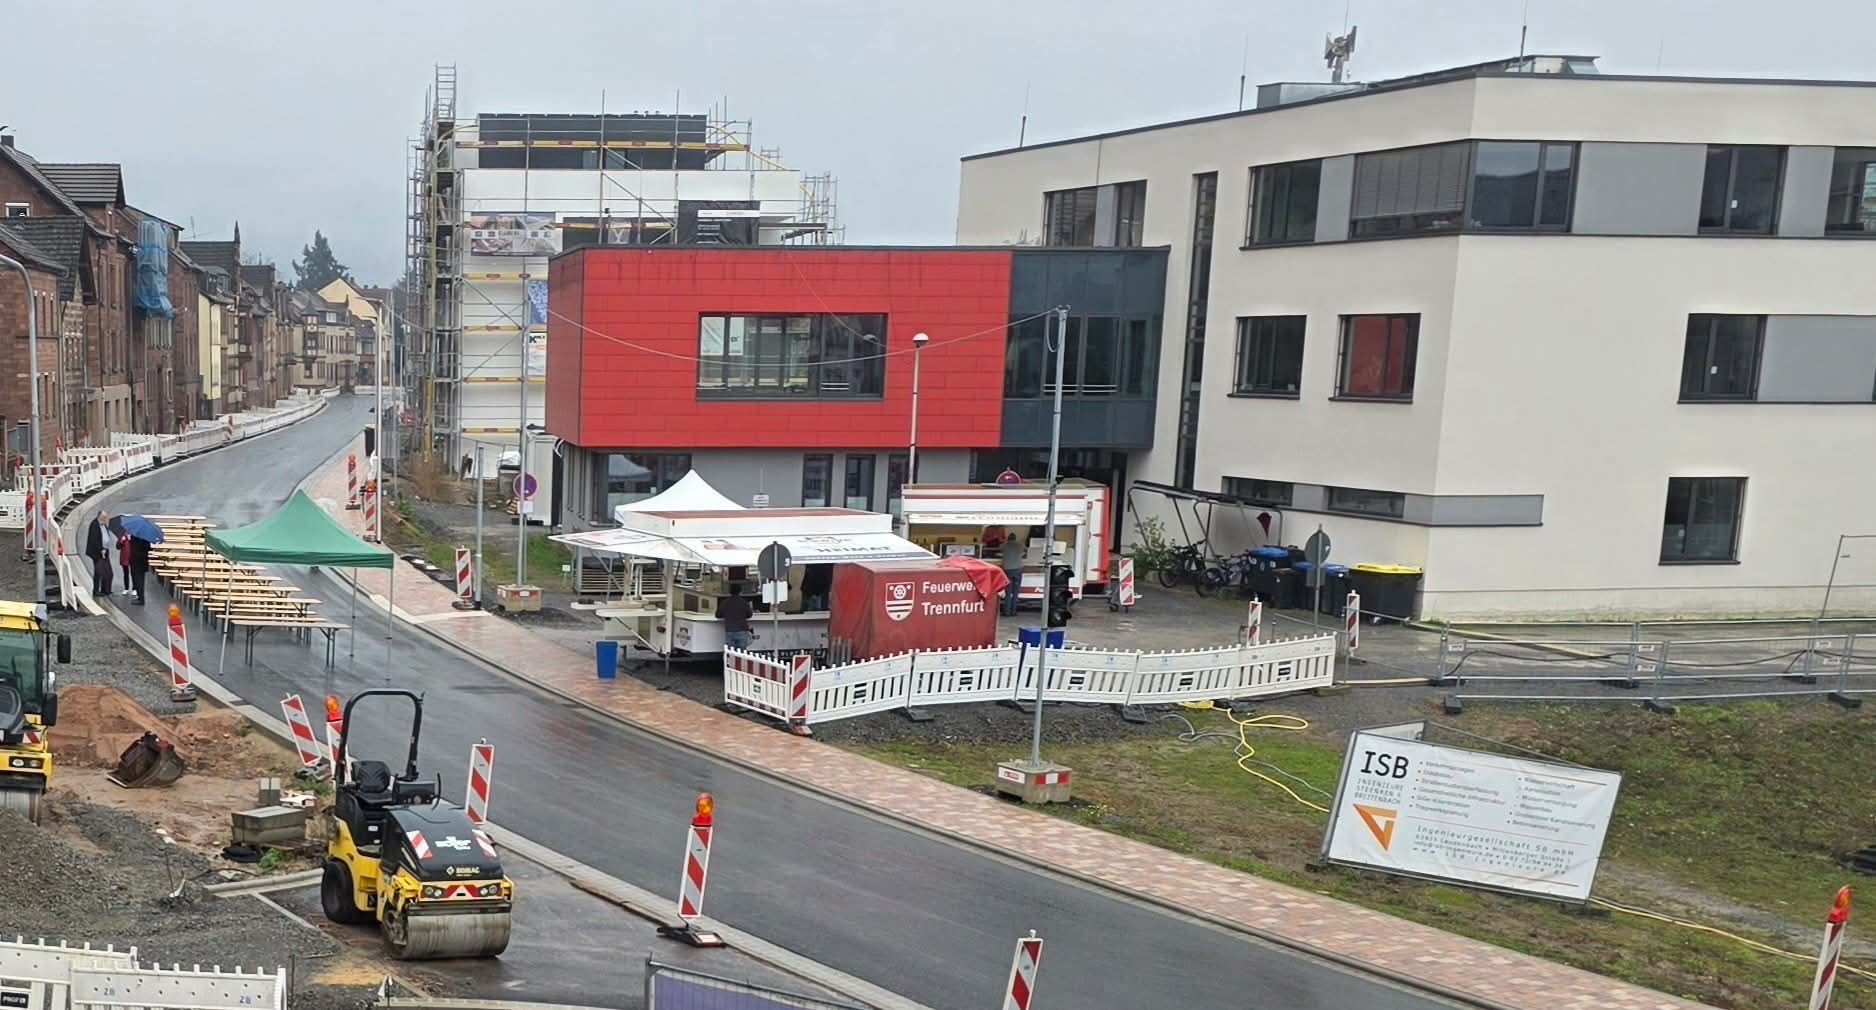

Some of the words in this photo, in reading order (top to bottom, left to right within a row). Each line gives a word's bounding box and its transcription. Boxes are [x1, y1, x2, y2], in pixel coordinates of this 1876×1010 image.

[922, 581, 976, 594] Feuerwe
[921, 600, 984, 616] Trennfurt
[1360, 751, 1409, 778] ISB
